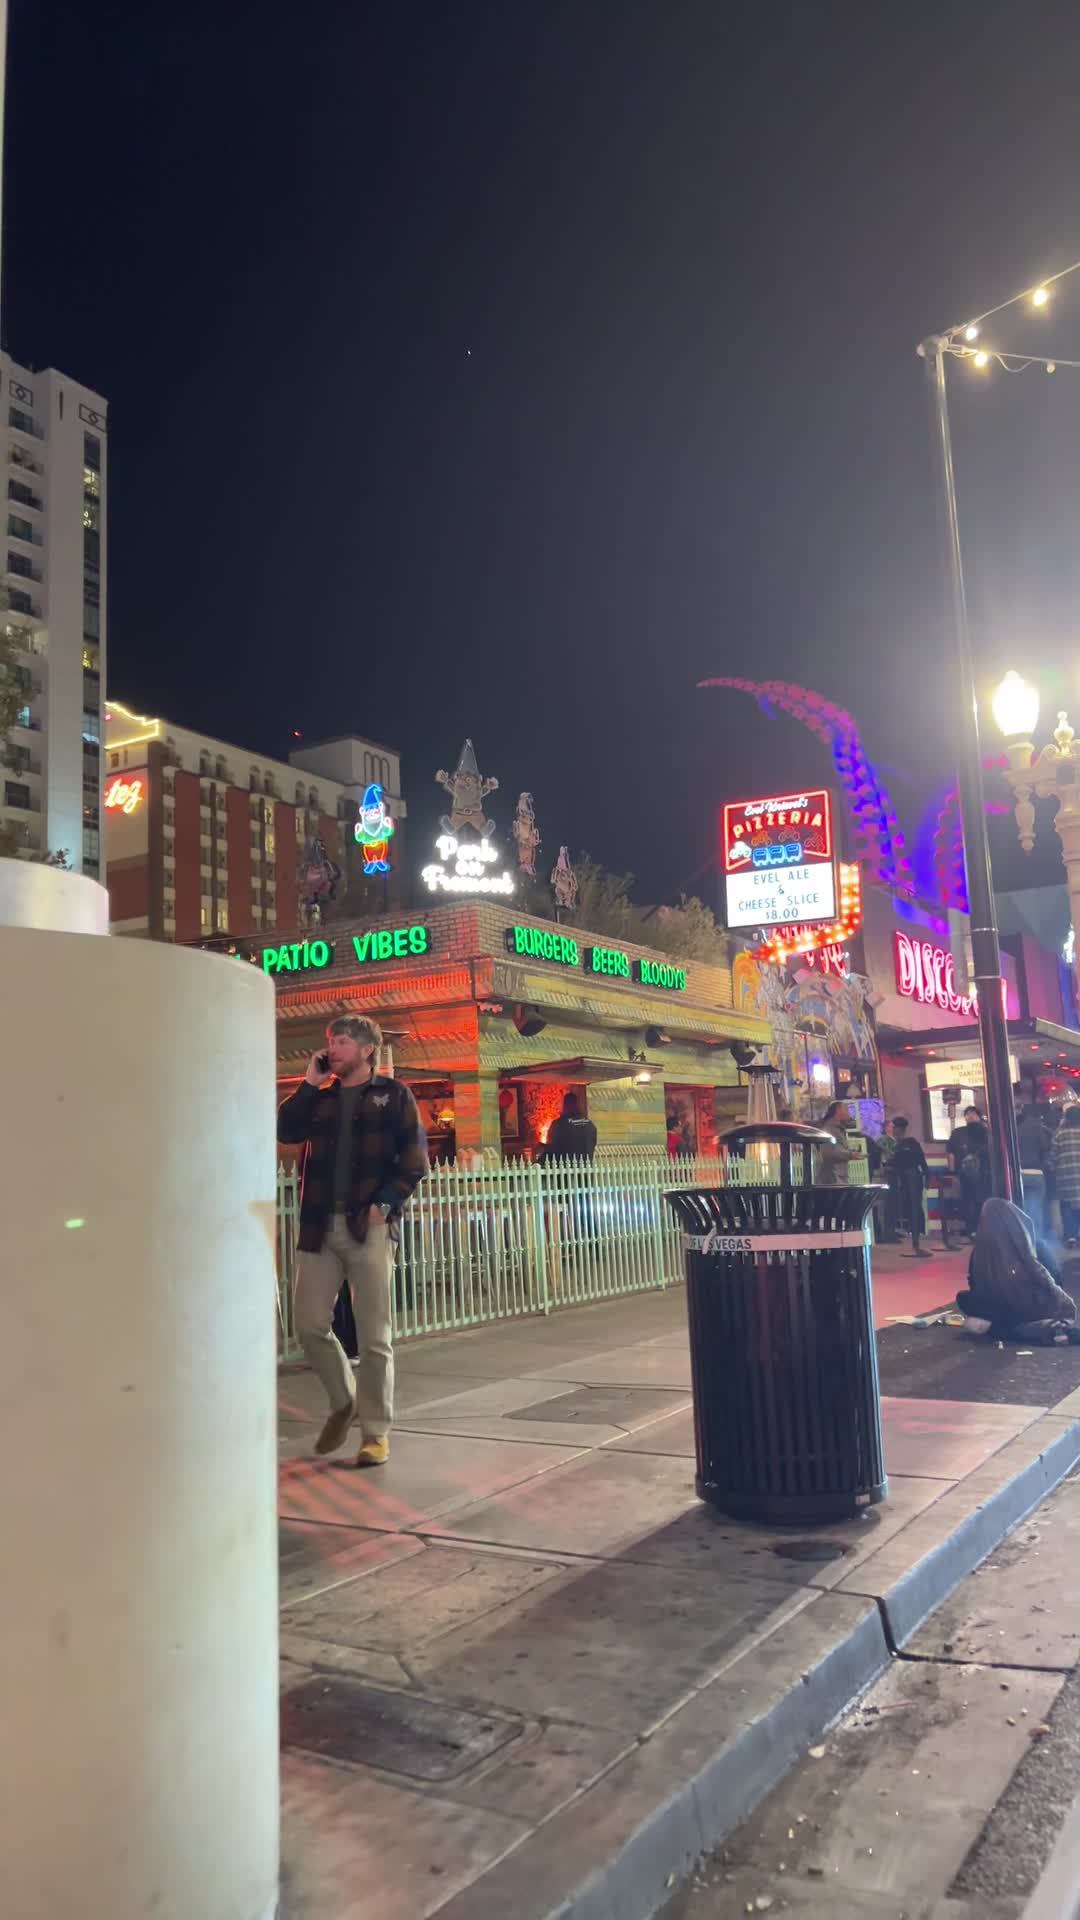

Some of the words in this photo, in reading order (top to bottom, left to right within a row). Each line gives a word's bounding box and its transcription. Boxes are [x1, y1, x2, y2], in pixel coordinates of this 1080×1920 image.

[733, 811, 822, 838] PIZZERIA
[753, 872, 781, 885] EVEL
[788, 868, 810, 881] ALE
[778, 885, 785, 895] &
[738, 897, 777, 911] CHEESE
[786, 893, 819, 906] SLICE
[765, 908, 799, 920] $8.00
[262, 941, 329, 976] PATIO
[353, 926, 427, 962] VIBES
[514, 926, 579, 966] BURGERS
[592, 947, 630, 977] BEERS
[640, 960, 687, 991] BLOODYS
[698, 1238, 713, 1249] LS
[716, 1238, 752, 1250] VEGAS
